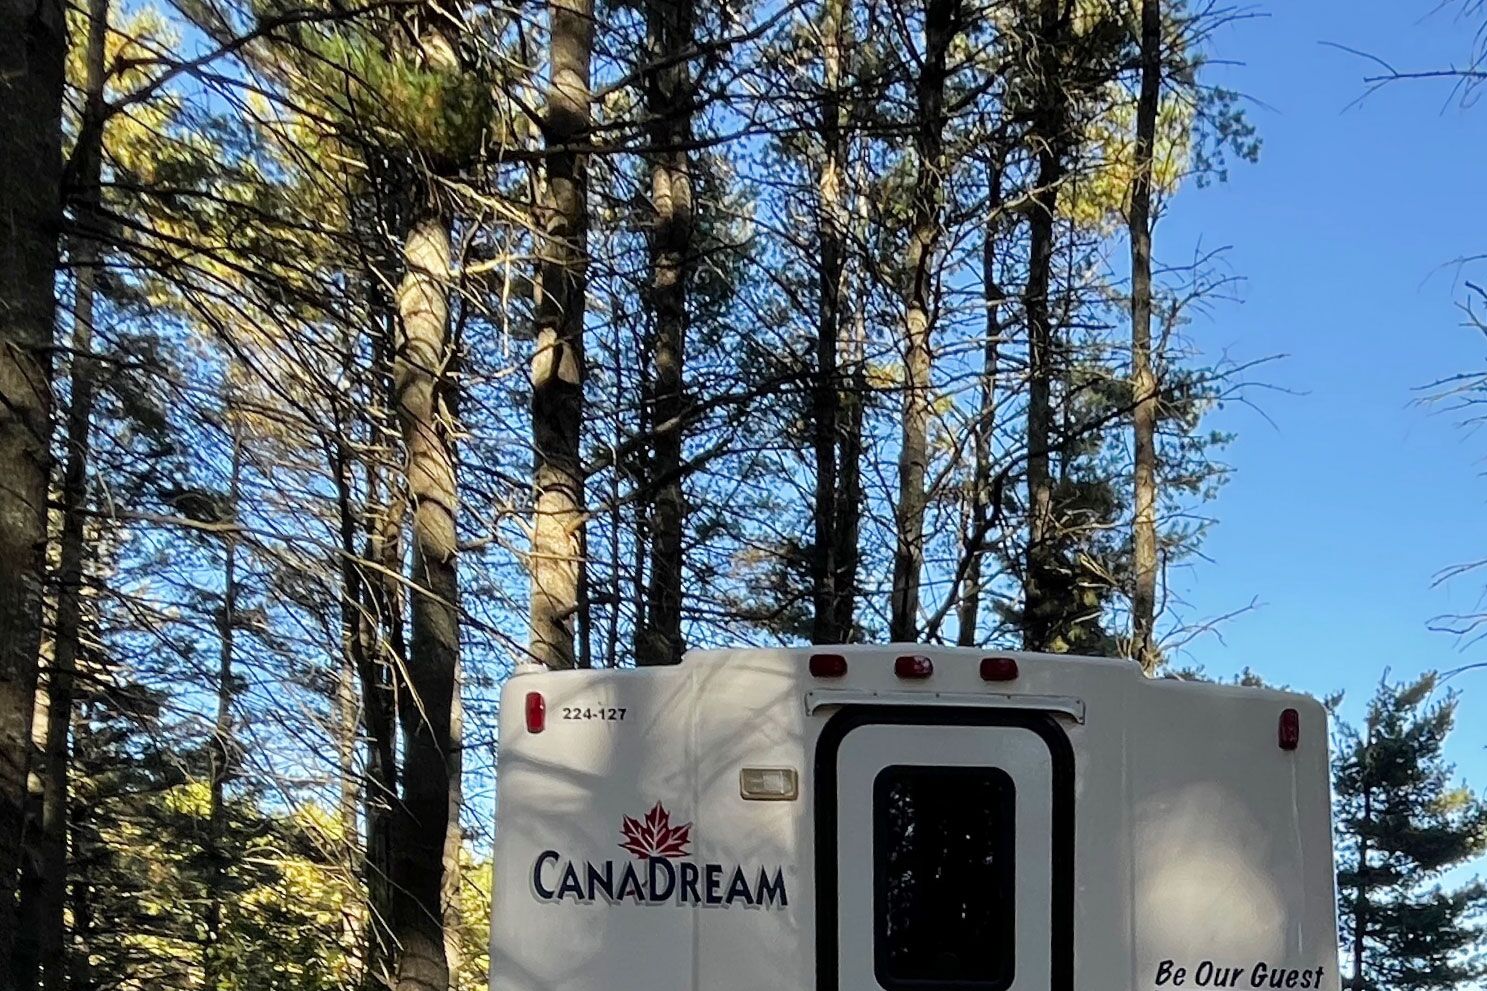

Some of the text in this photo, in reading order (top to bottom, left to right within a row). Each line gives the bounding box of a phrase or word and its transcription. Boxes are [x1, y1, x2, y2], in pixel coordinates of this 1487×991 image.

[562, 708, 626, 721] 224-127
[1155, 959, 1325, 989] Be Our Guest
